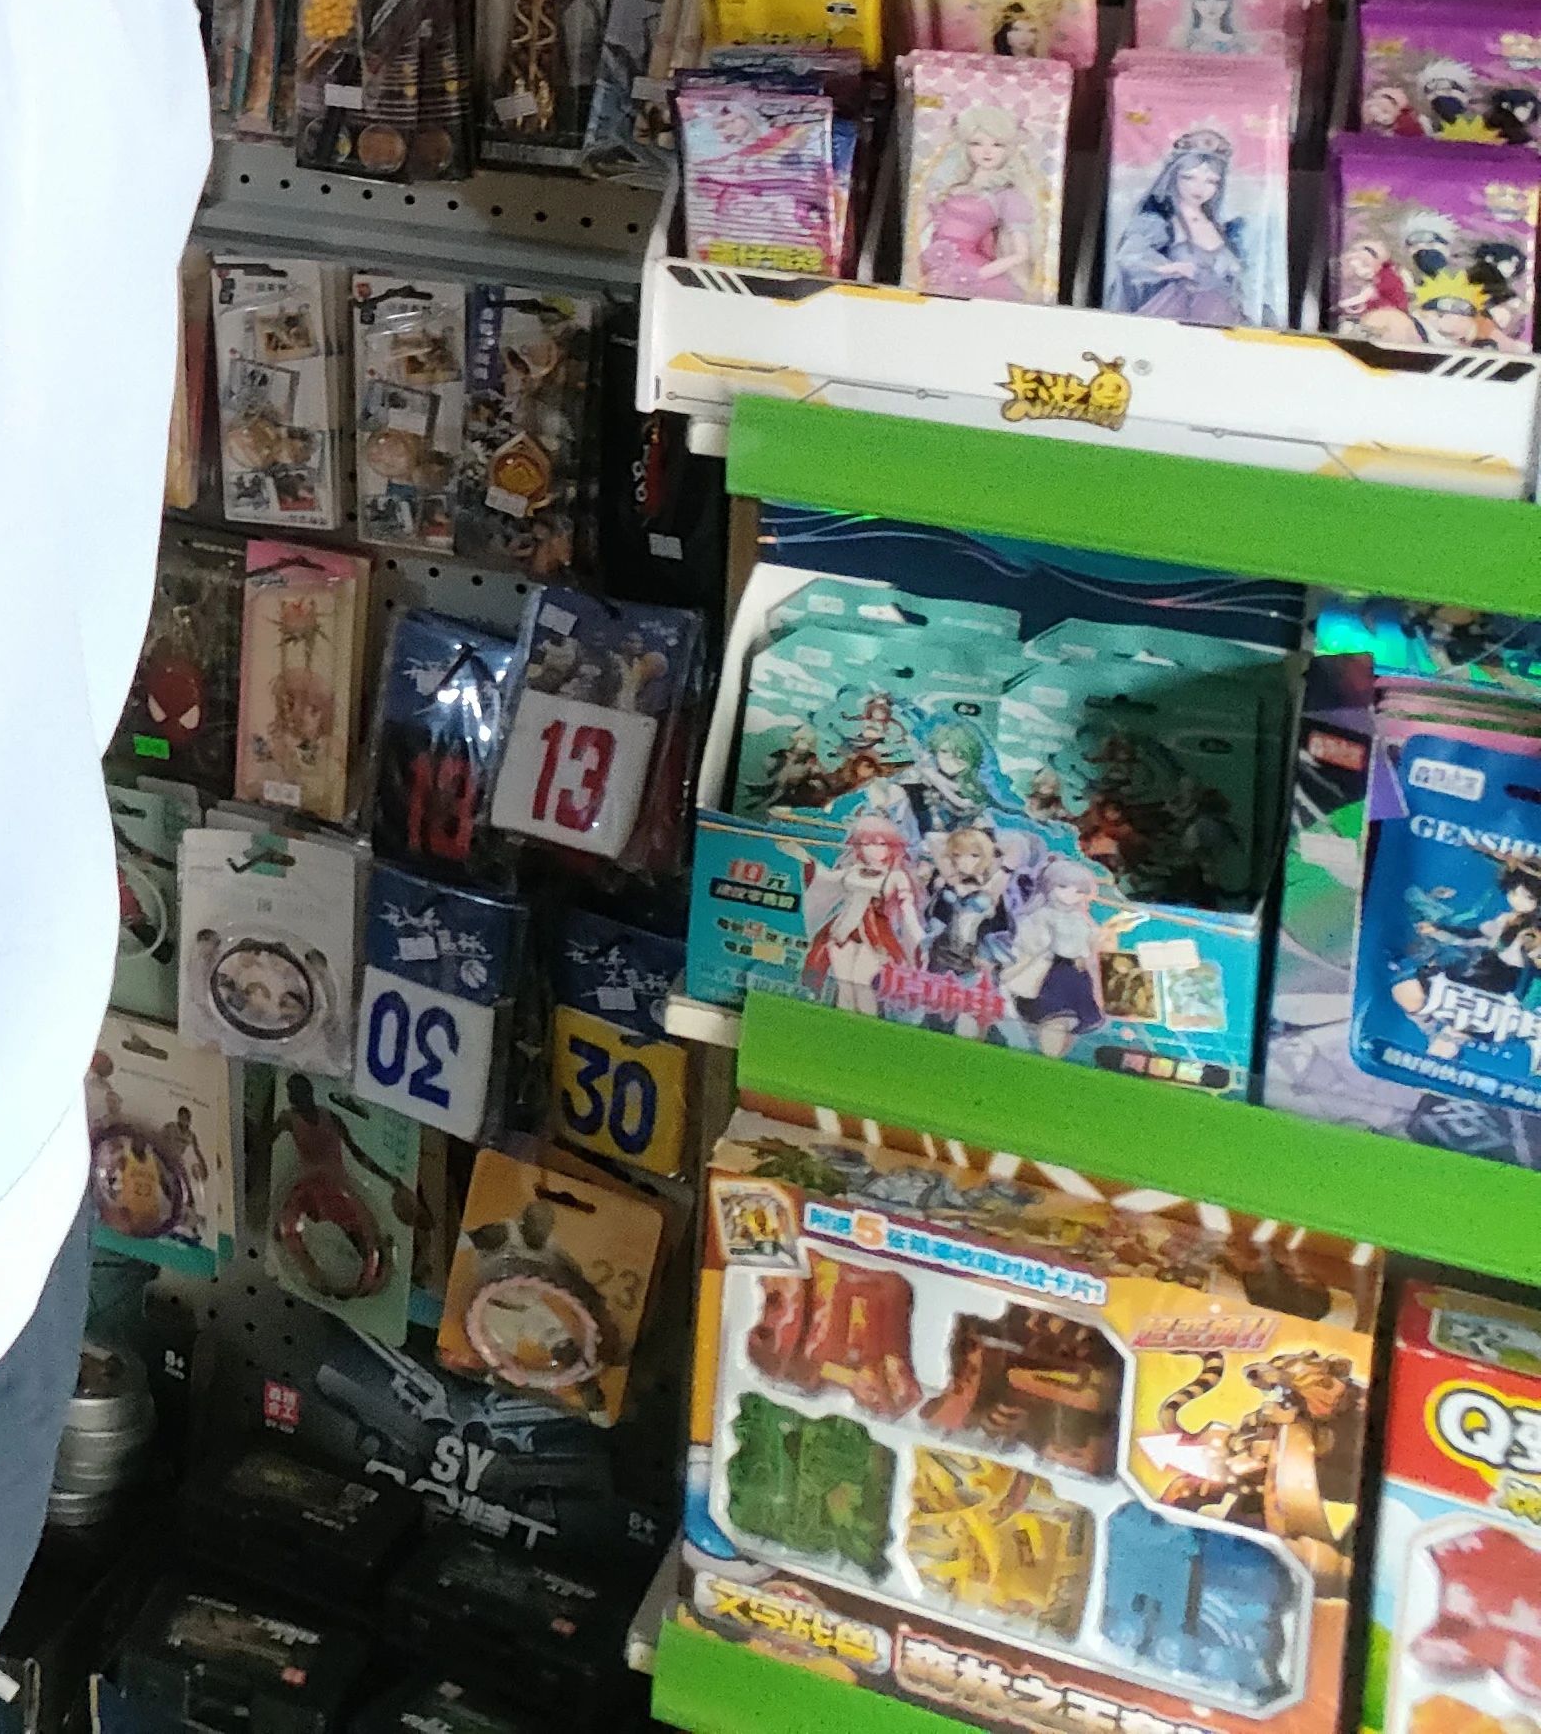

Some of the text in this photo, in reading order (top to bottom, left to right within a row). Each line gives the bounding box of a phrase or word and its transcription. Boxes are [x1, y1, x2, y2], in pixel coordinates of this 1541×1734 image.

[532, 718, 618, 833] 13
[563, 1037, 658, 1155] 30
[430, 1434, 497, 1493] SY
